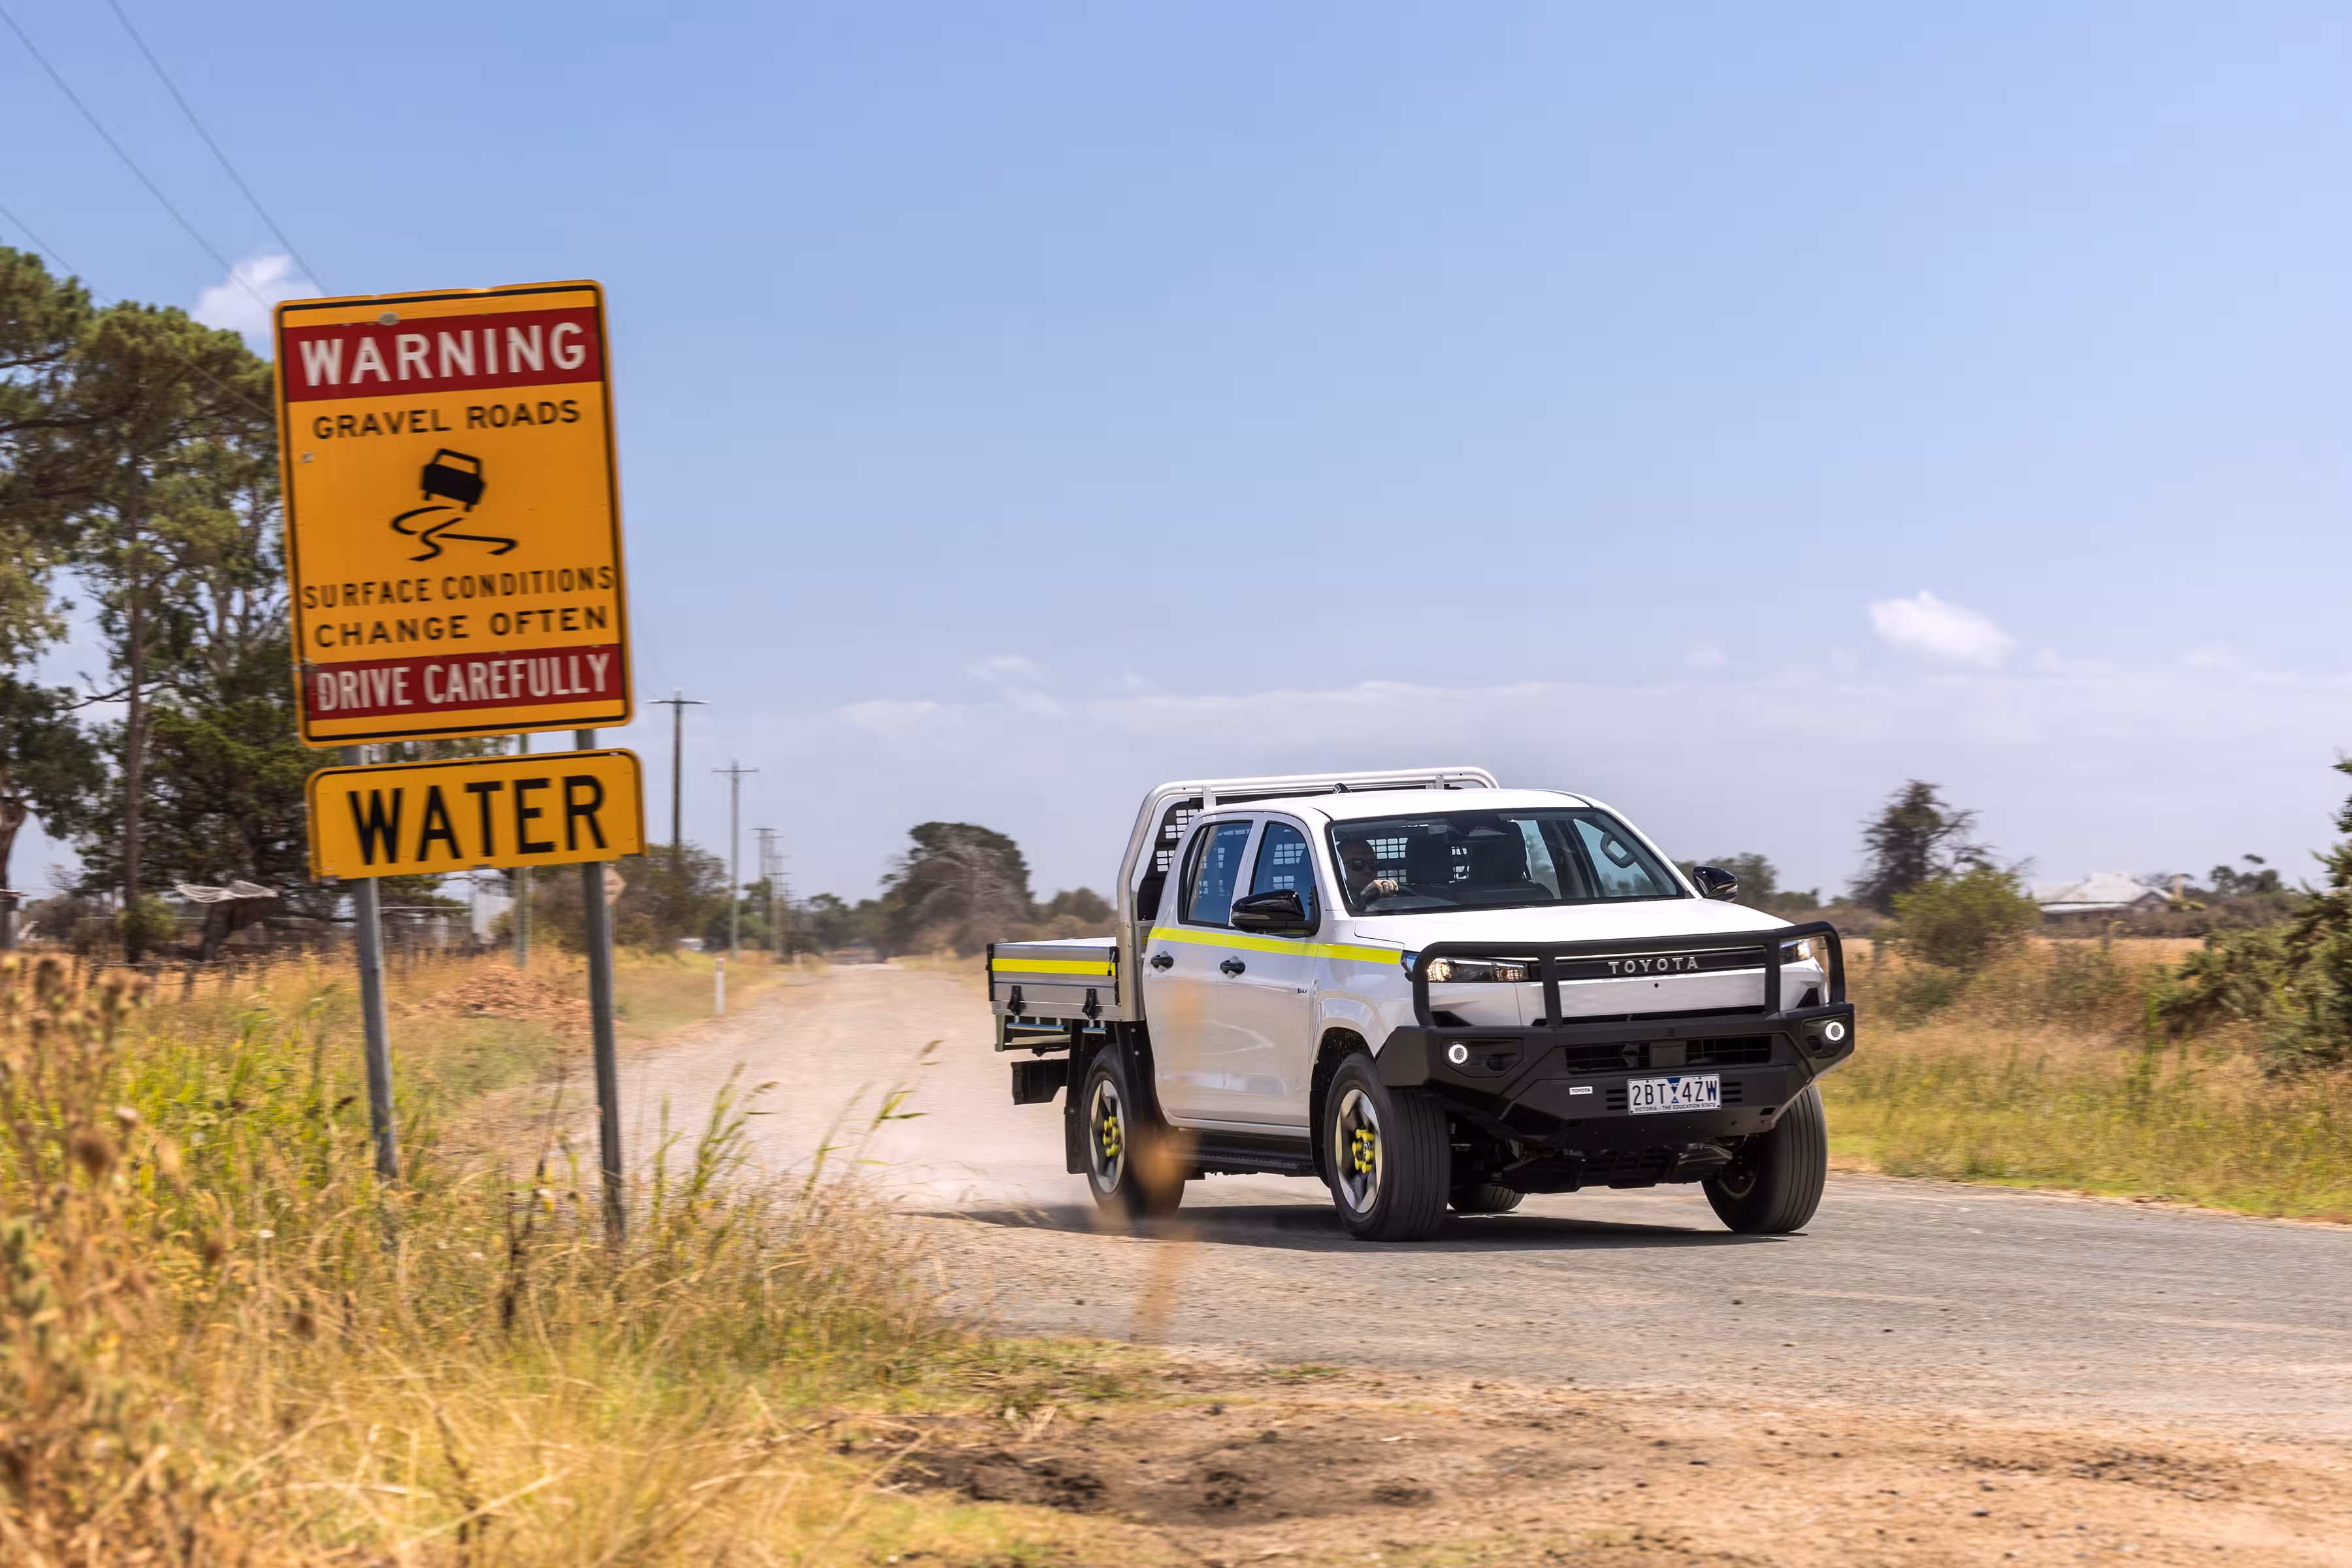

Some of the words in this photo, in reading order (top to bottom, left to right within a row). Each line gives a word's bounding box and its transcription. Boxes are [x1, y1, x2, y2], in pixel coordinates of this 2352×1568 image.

[299, 322, 586, 387] WARNING
[313, 409, 451, 440] GRAVEL
[466, 399, 580, 429] ROADS
[301, 578, 432, 609] SURFACE
[442, 565, 614, 600] CONDITIONS
[315, 615, 469, 647] CHANGE
[489, 606, 607, 636] OFTEN
[317, 666, 414, 711] DRIVE
[423, 653, 611, 704] CAREFULLY
[346, 775, 608, 866] WATER
[1608, 956, 1699, 974] TOYOTA
[1632, 1083, 1665, 1105] 2BT
[1682, 1081, 1718, 1102] 4ZW
